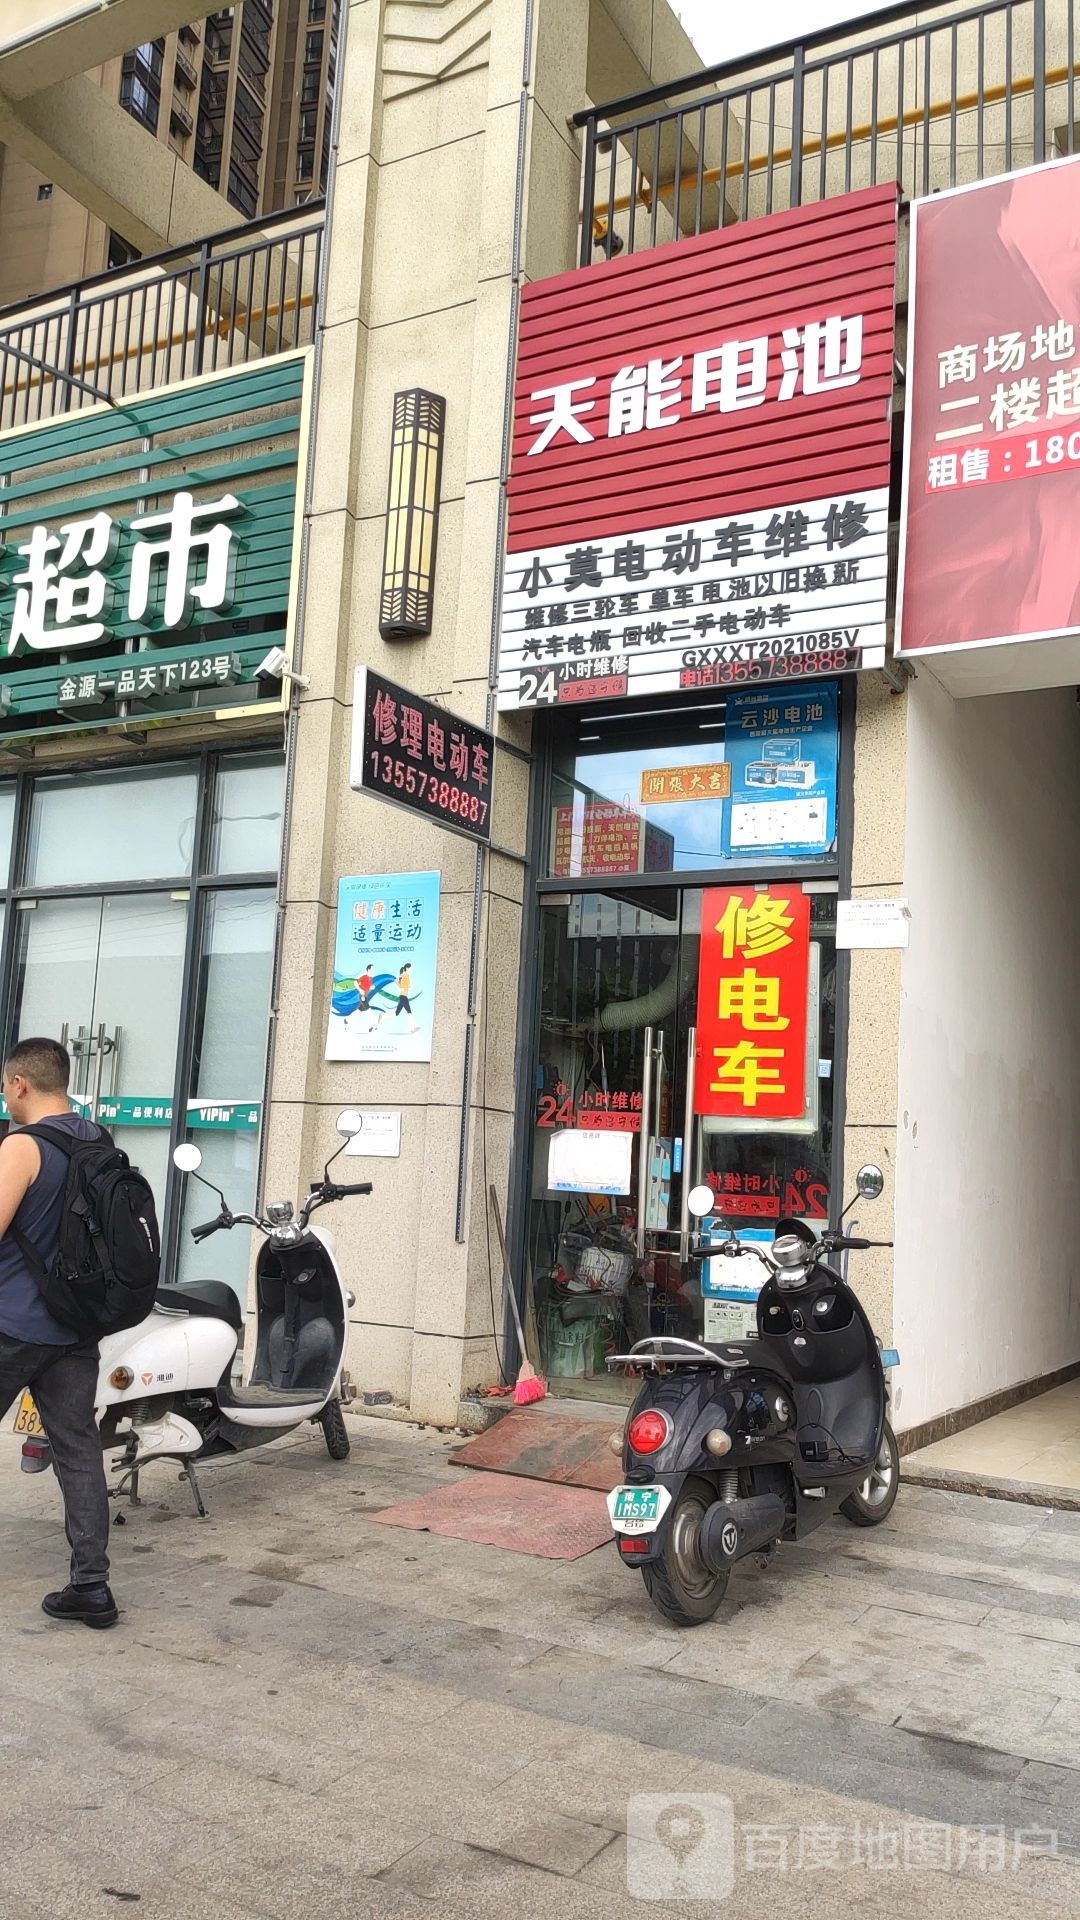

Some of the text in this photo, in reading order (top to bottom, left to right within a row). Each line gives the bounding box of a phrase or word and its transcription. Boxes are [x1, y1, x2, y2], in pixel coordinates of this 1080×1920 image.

[527, 314, 863, 456] 天能电池
[935, 367, 1080, 441] 二楼超
[518, 501, 870, 599] 小莫电动车维修
[8, 492, 246, 656] 超市
[682, 629, 860, 667] GXXXT2021085V
[60, 655, 232, 701] 金源一品天下123号
[519, 655, 628, 706] 24 小时维修
[741, 703, 823, 729] 云沙电池
[372, 689, 489, 792] 修理电动车
[371, 751, 488, 825] 13557388887
[354, 899, 422, 919] 健康生活
[353, 923, 422, 942] 适量运动
[710, 893, 795, 1107] 修电车
[123, 1105, 172, 1119] 一品便利店
[537, 1094, 576, 1128] 24
[578, 1091, 642, 1110] 小时维修
[617, 1503, 655, 1517] 1MS97
[624, 1491, 652, 1502] 南宁
